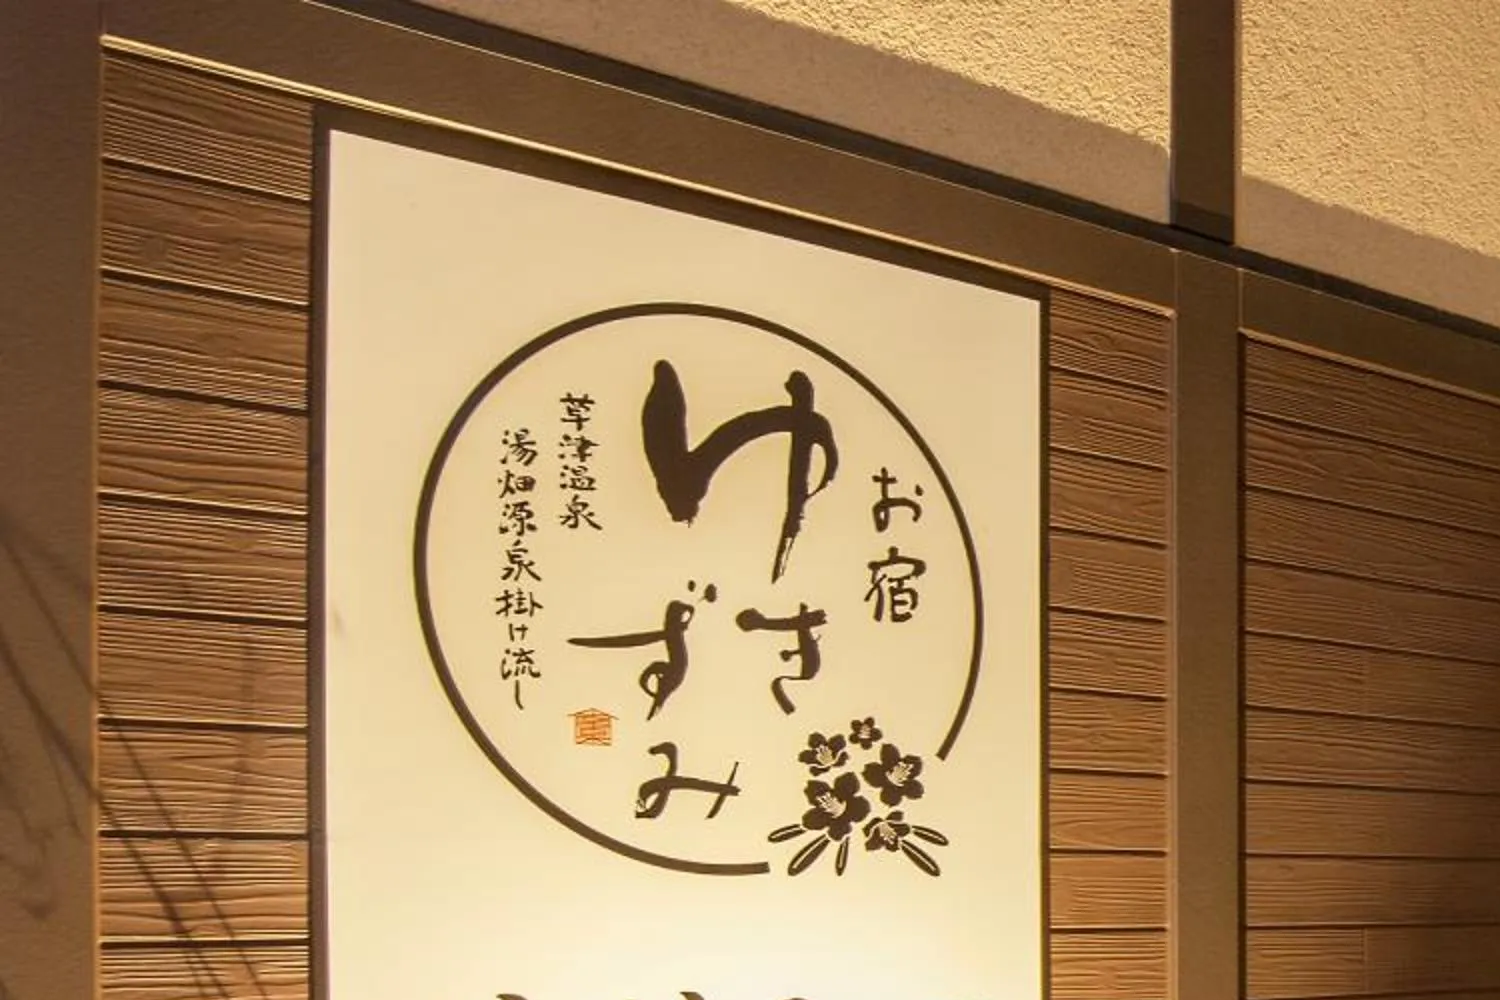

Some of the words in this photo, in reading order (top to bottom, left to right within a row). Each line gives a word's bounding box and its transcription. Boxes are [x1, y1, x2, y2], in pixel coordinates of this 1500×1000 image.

[558, 392, 603, 531] 草津温泉
[495, 428, 543, 711] 湯畑源泉掛け流し
[864, 467, 927, 623] お宿
